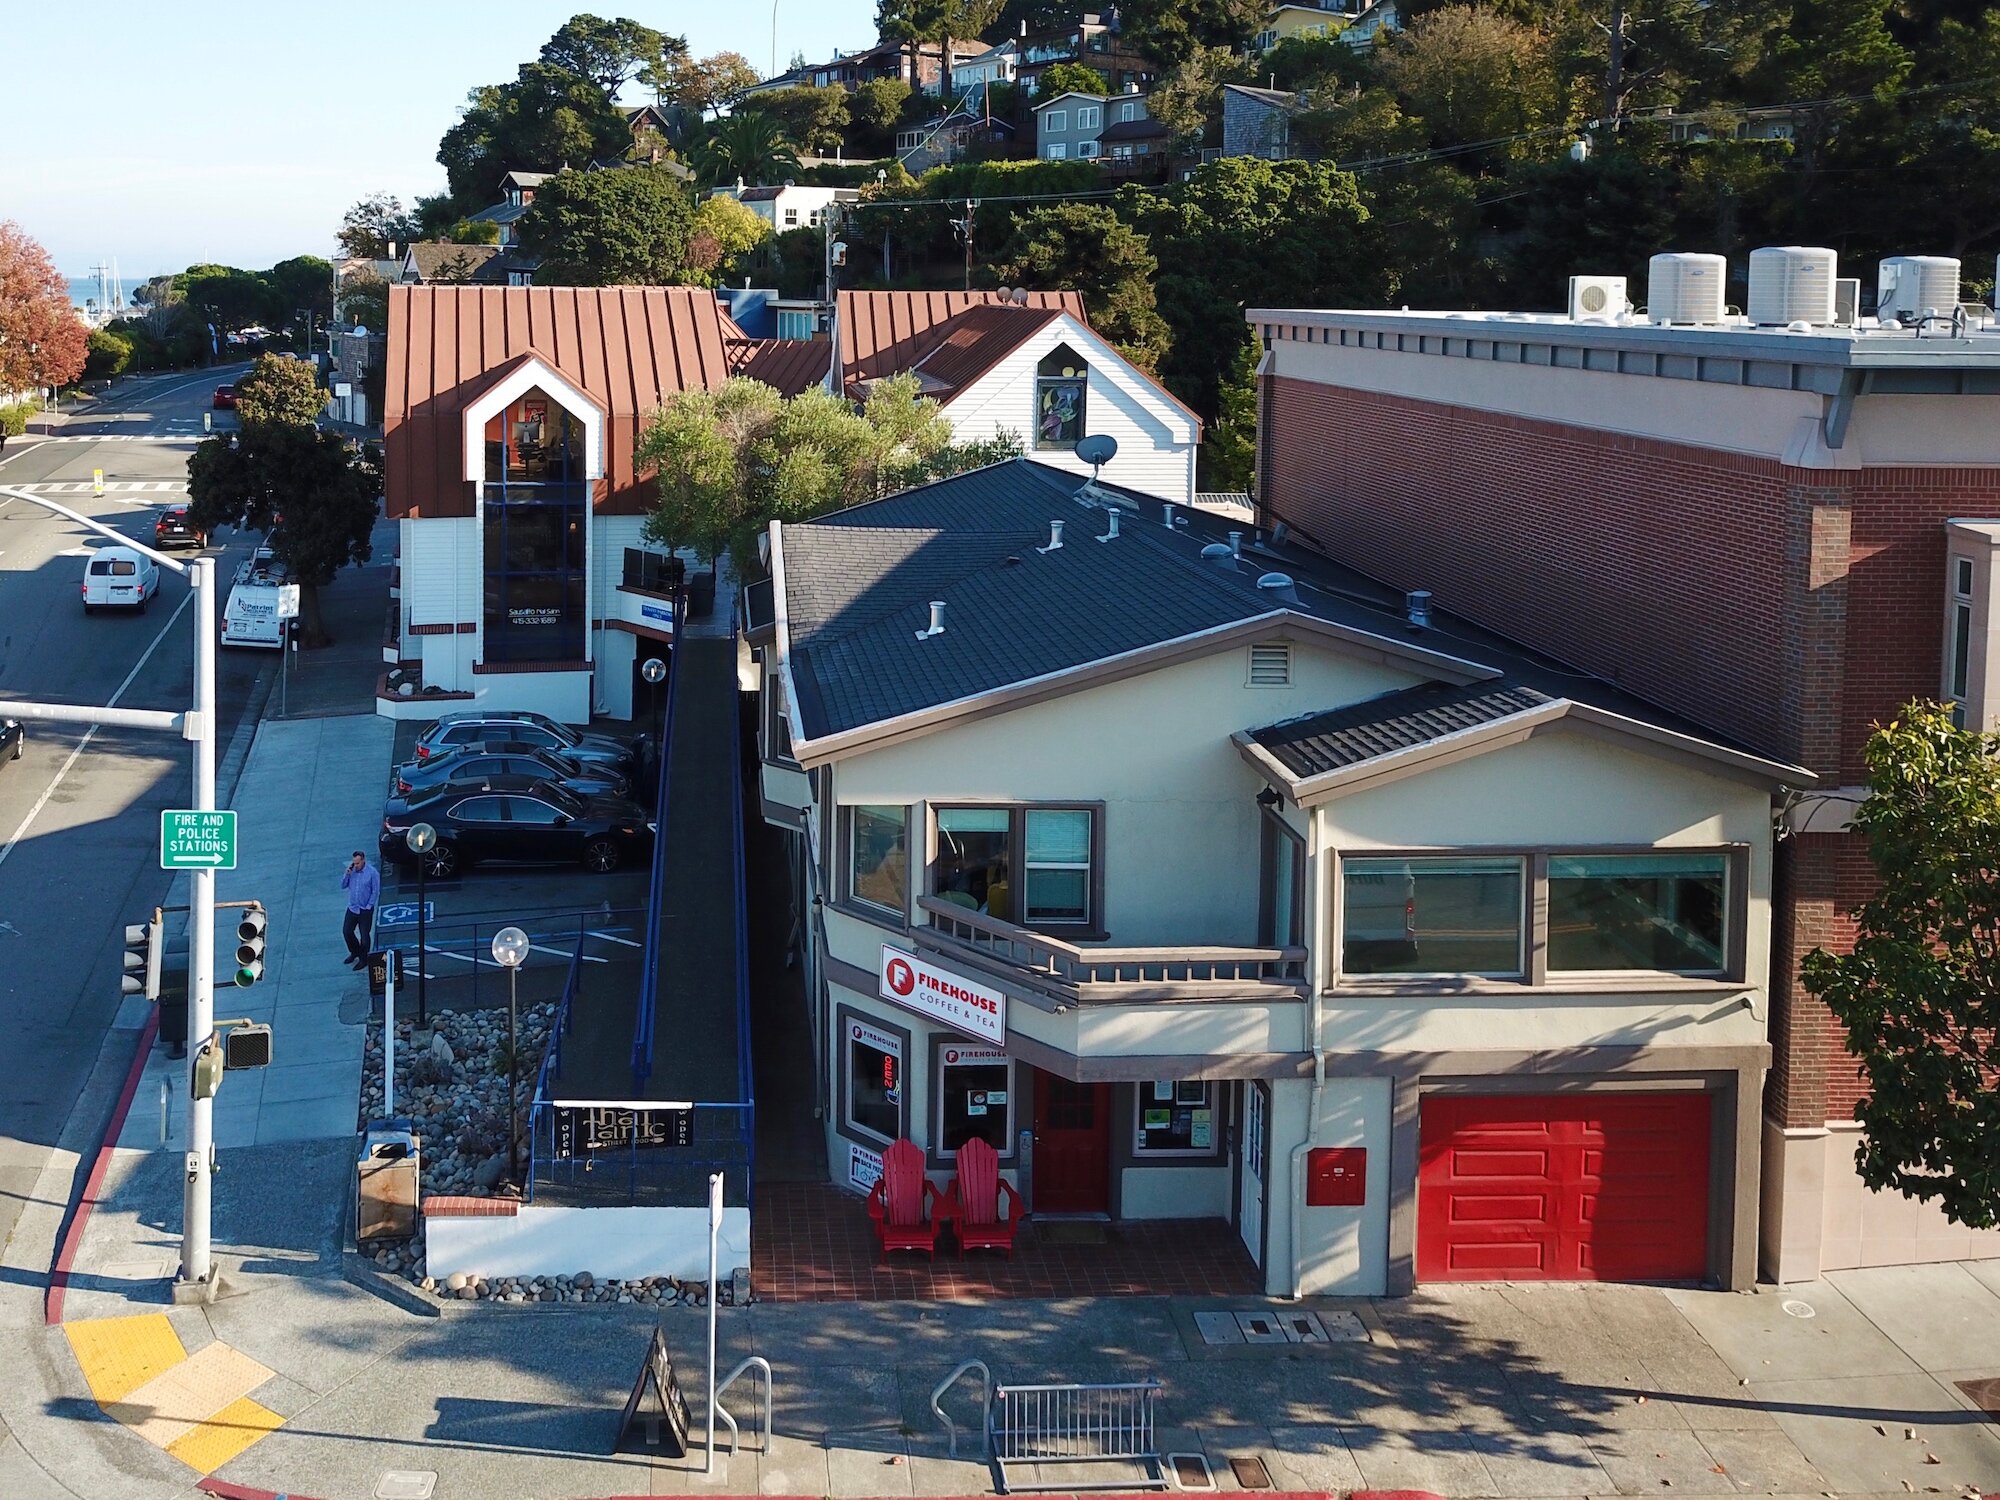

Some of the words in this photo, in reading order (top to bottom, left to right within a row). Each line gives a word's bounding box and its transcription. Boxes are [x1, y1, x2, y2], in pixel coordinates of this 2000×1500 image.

[174, 814, 197, 826] FIRE
[202, 814, 224, 826] AND
[178, 827, 220, 839] POLICE
[170, 840, 228, 852] STATIONS
[918, 972, 997, 1015] FIREHOUSE
[919, 992, 959, 1015] COFFEE
[963, 1010, 970, 1019] &
[975, 1014, 996, 1030] TEA
[863, 1030, 898, 1050] FIREHOUSE
[858, 1149, 883, 1166] FIREHO
